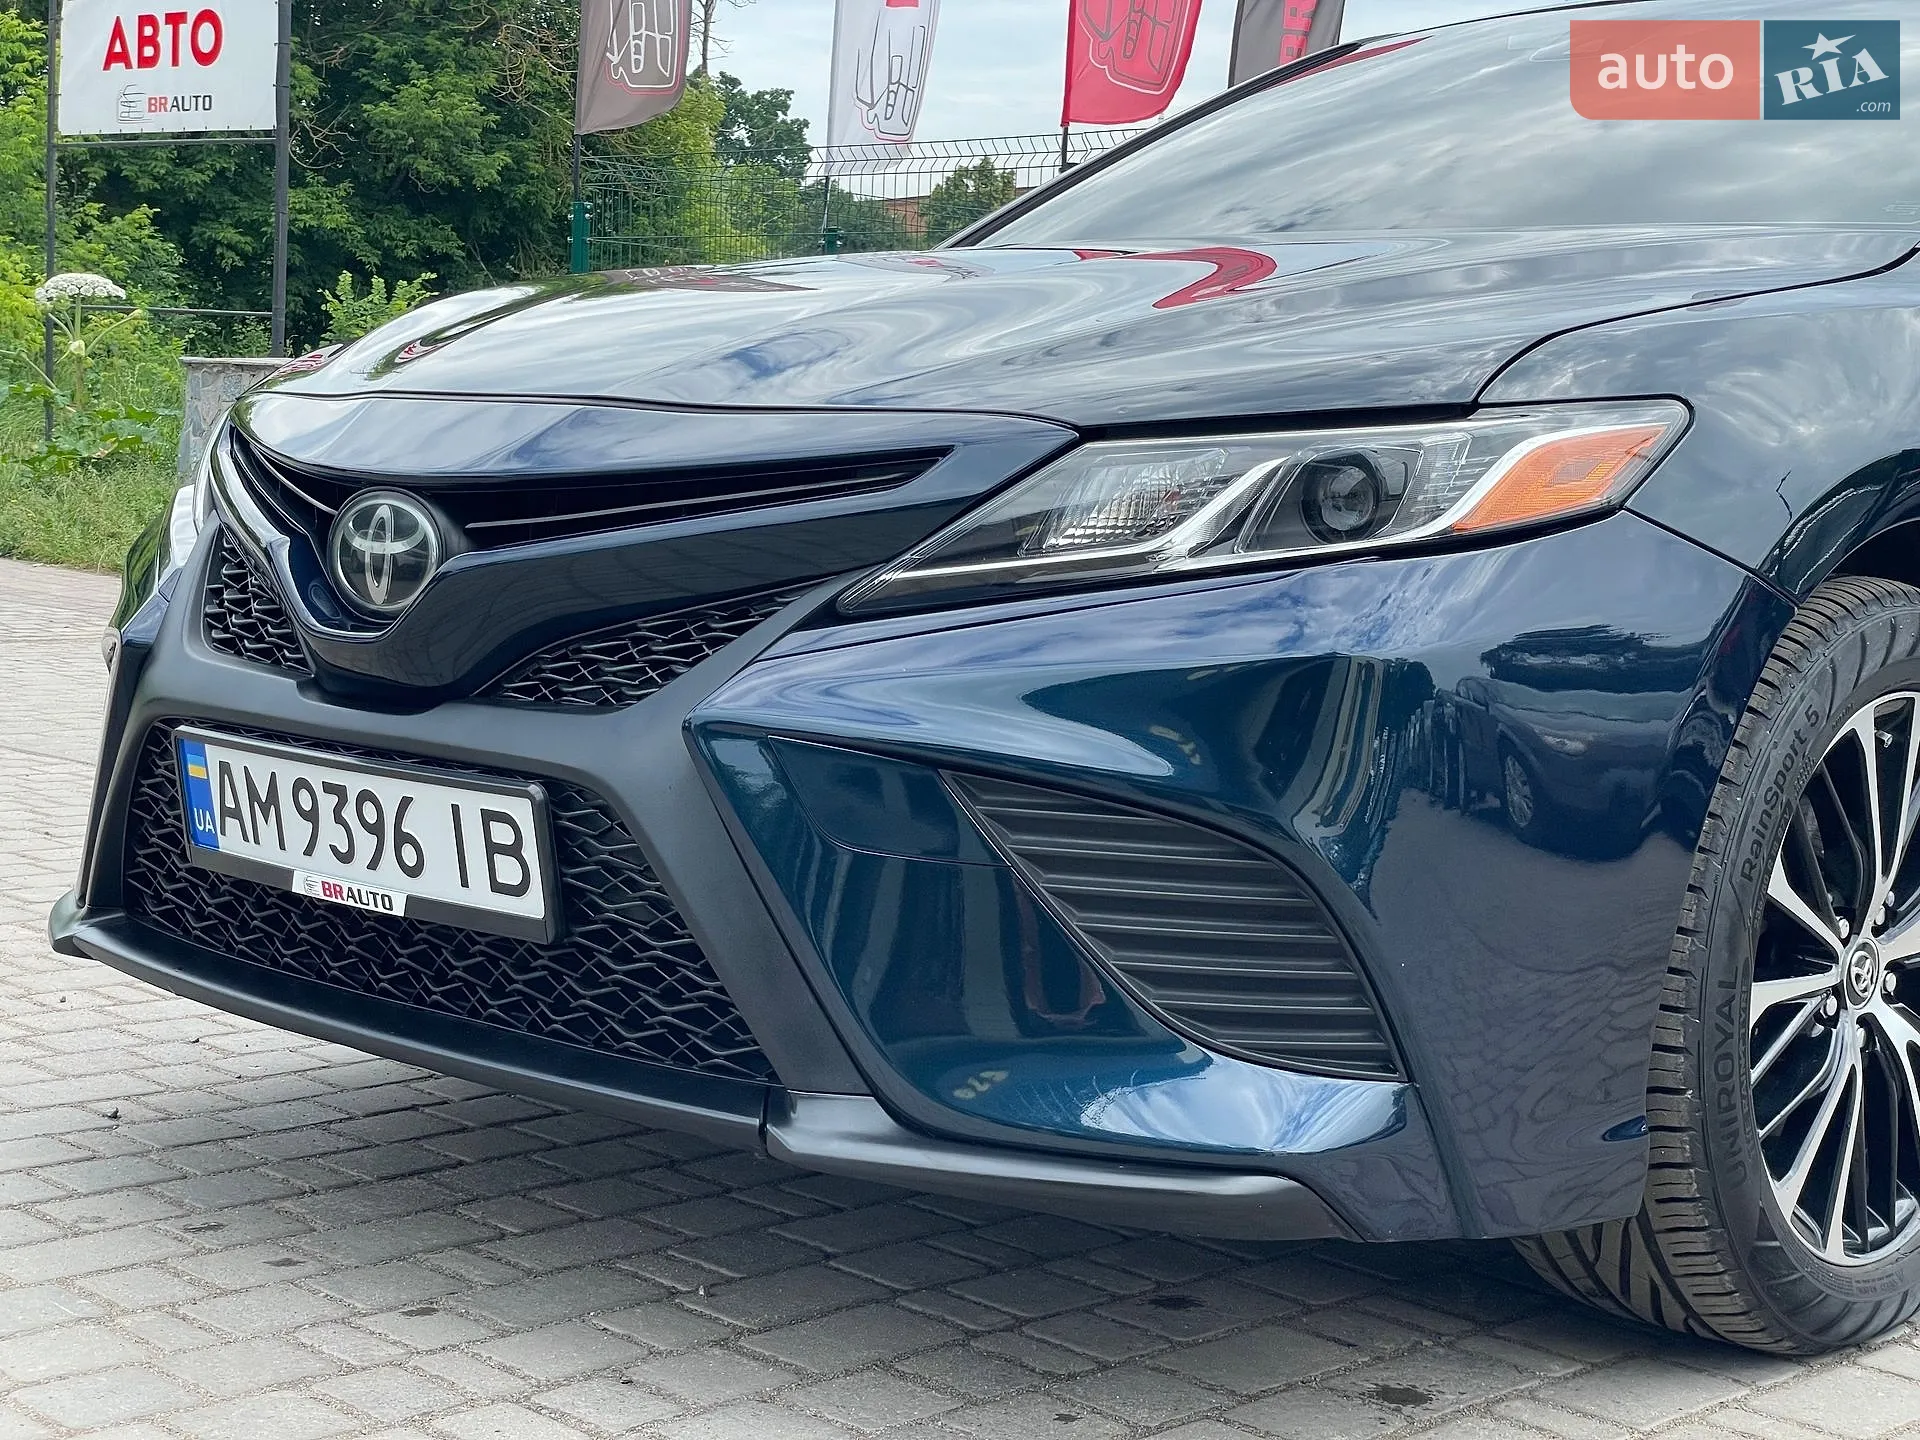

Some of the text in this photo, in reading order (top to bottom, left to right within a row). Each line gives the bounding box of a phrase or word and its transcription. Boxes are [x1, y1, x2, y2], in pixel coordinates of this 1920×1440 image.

[102, 8, 224, 71] АВТО
[147, 94, 213, 113] BRAUTO
[1741, 728, 1808, 883] RainSport
[1804, 703, 1820, 728] 5
[194, 807, 215, 834] UA
[321, 880, 394, 912] BRAUTO
[1714, 966, 1747, 1190] UNIROYAL
